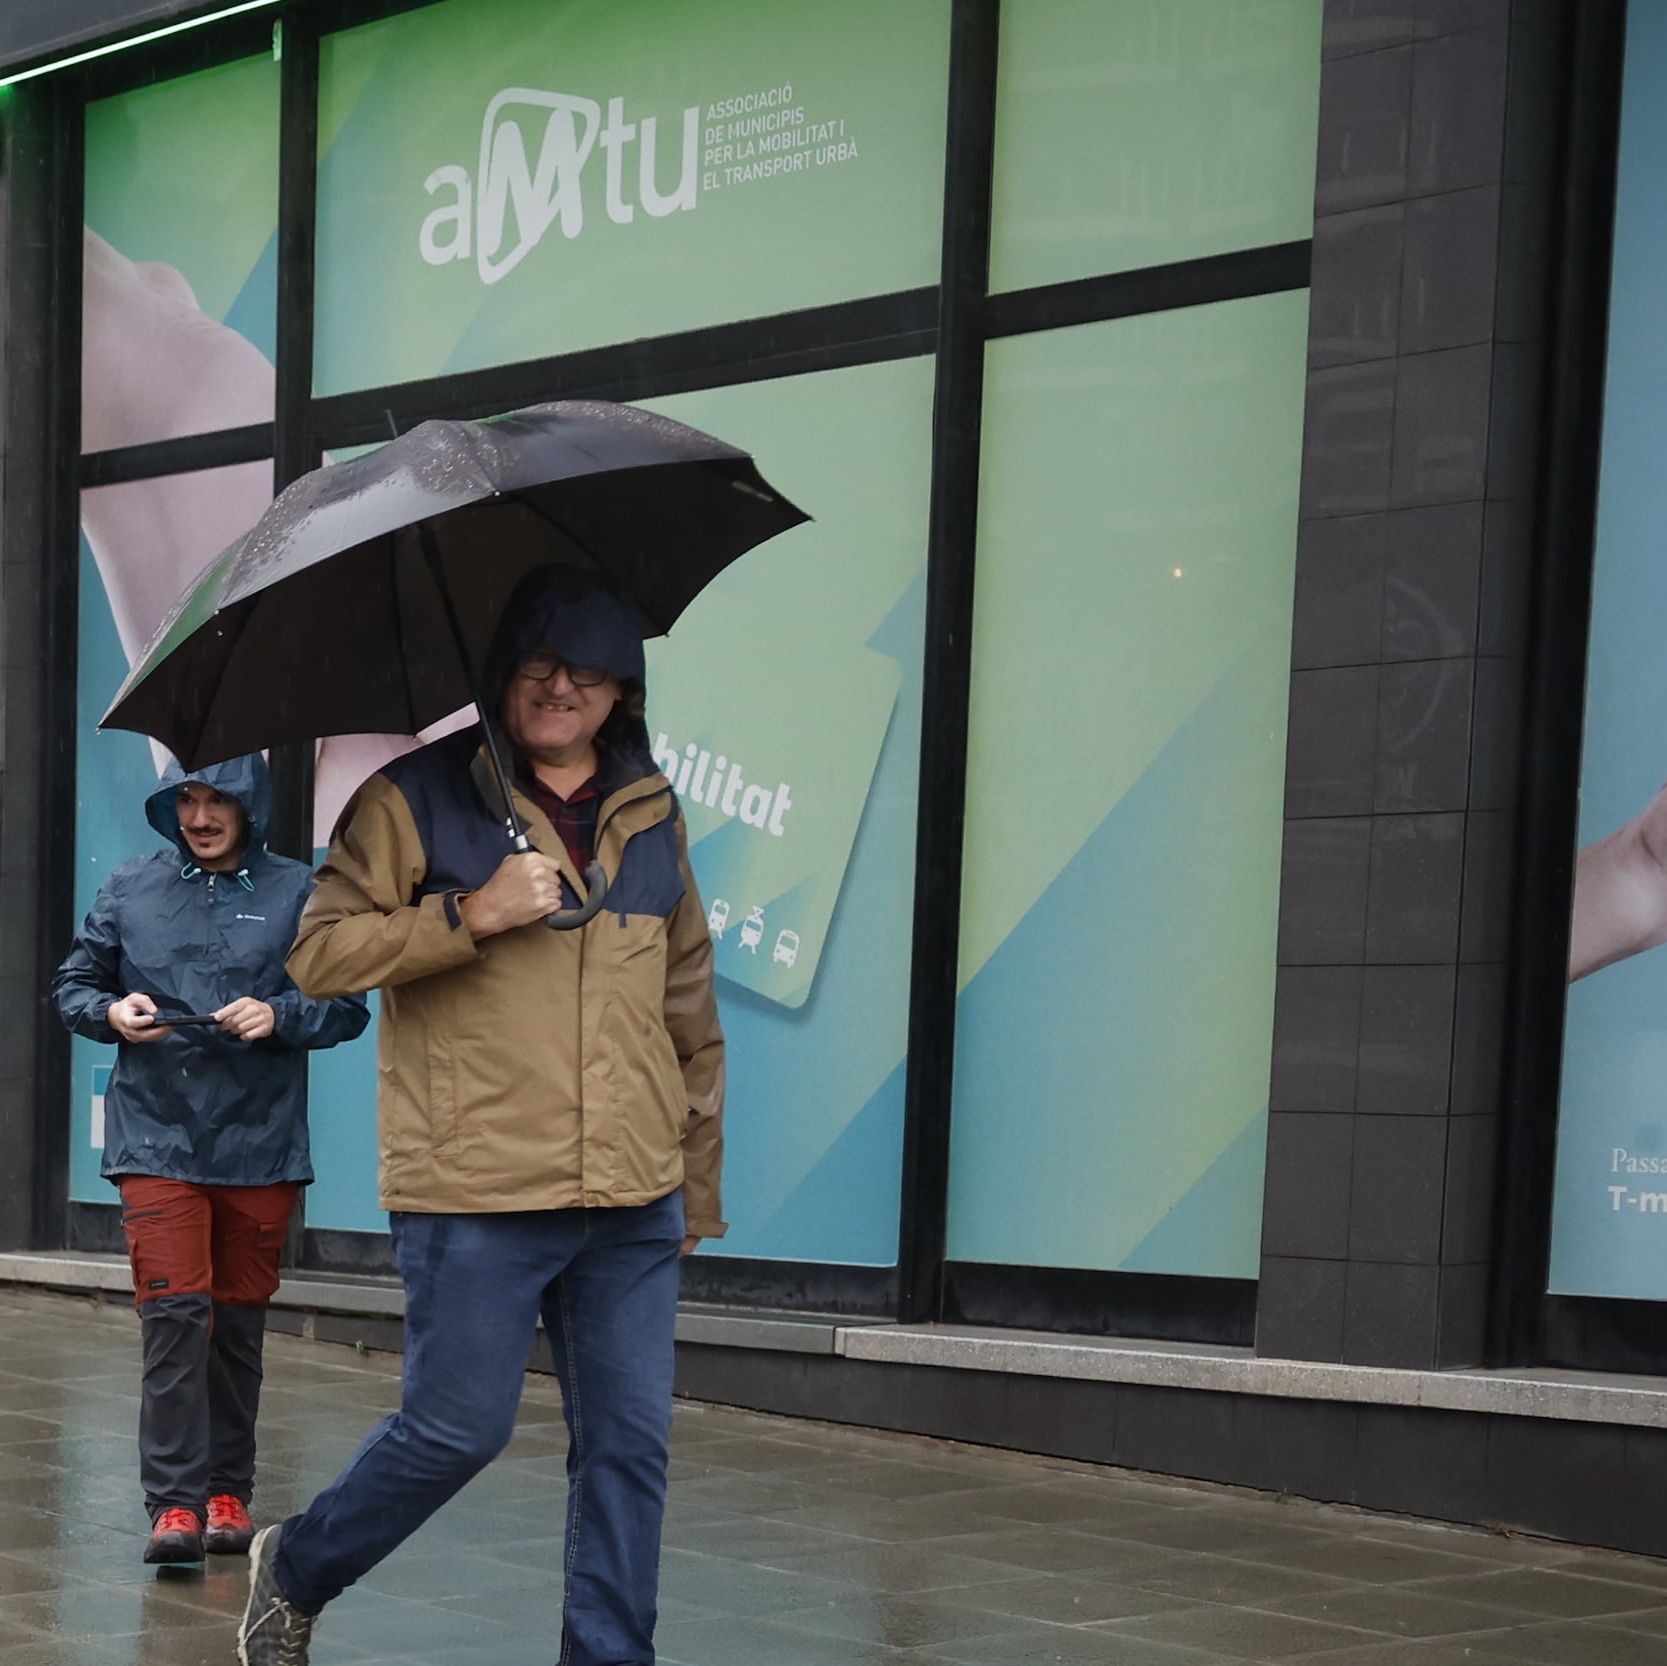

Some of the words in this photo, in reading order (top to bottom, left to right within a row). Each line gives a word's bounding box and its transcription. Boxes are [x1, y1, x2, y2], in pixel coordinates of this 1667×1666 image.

[707, 81, 793, 121] ASSOCIACIÓ
[704, 145, 732, 167] PER
[737, 141, 755, 160] LA
[759, 120, 836, 155] MOBILITAT
[839, 119, 845, 137] I
[705, 125, 724, 145] DE
[728, 107, 804, 140] MUNICIPIS
[703, 172, 720, 191] EL
[724, 151, 812, 186] TRANSPORT
[816, 137, 858, 165] URBÀ
